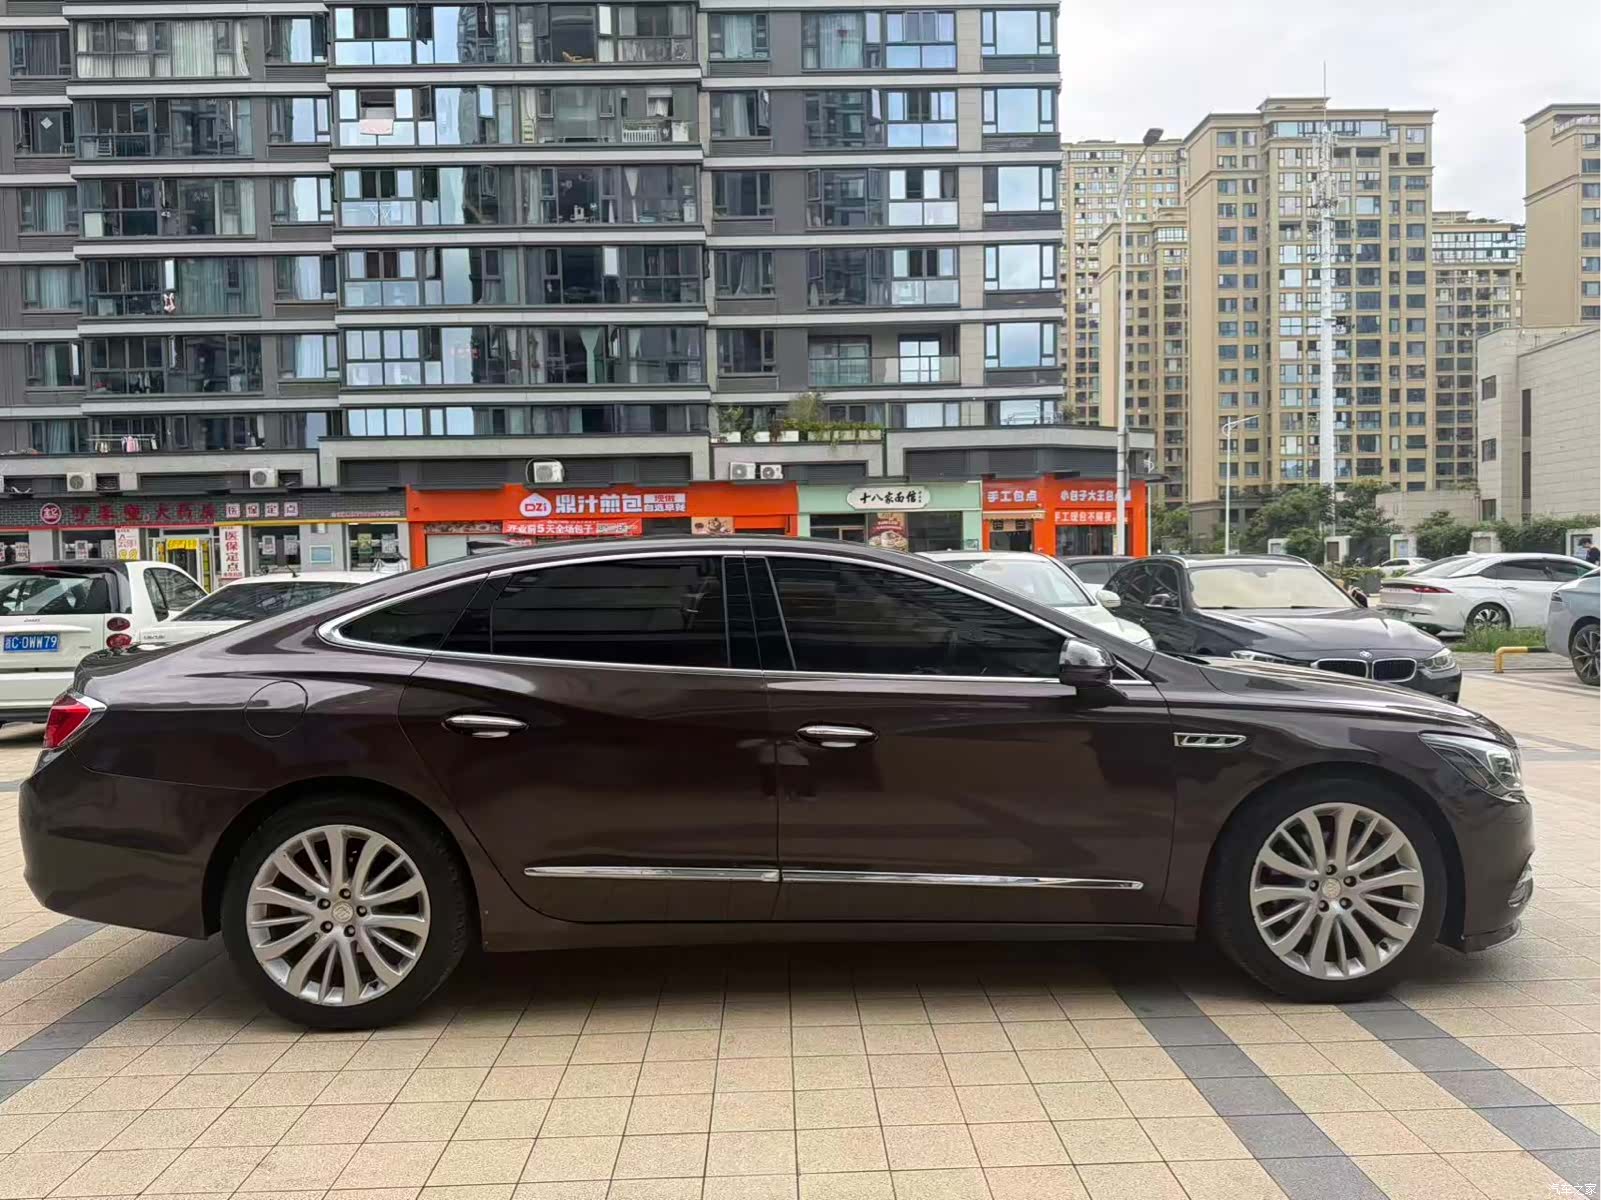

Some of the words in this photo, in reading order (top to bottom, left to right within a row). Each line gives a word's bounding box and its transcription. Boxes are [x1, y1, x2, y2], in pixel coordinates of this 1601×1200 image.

[987, 490, 1037, 502] 手工包点
[226, 502, 298, 517] 医保定点
[225, 531, 239, 572] 医保定点
